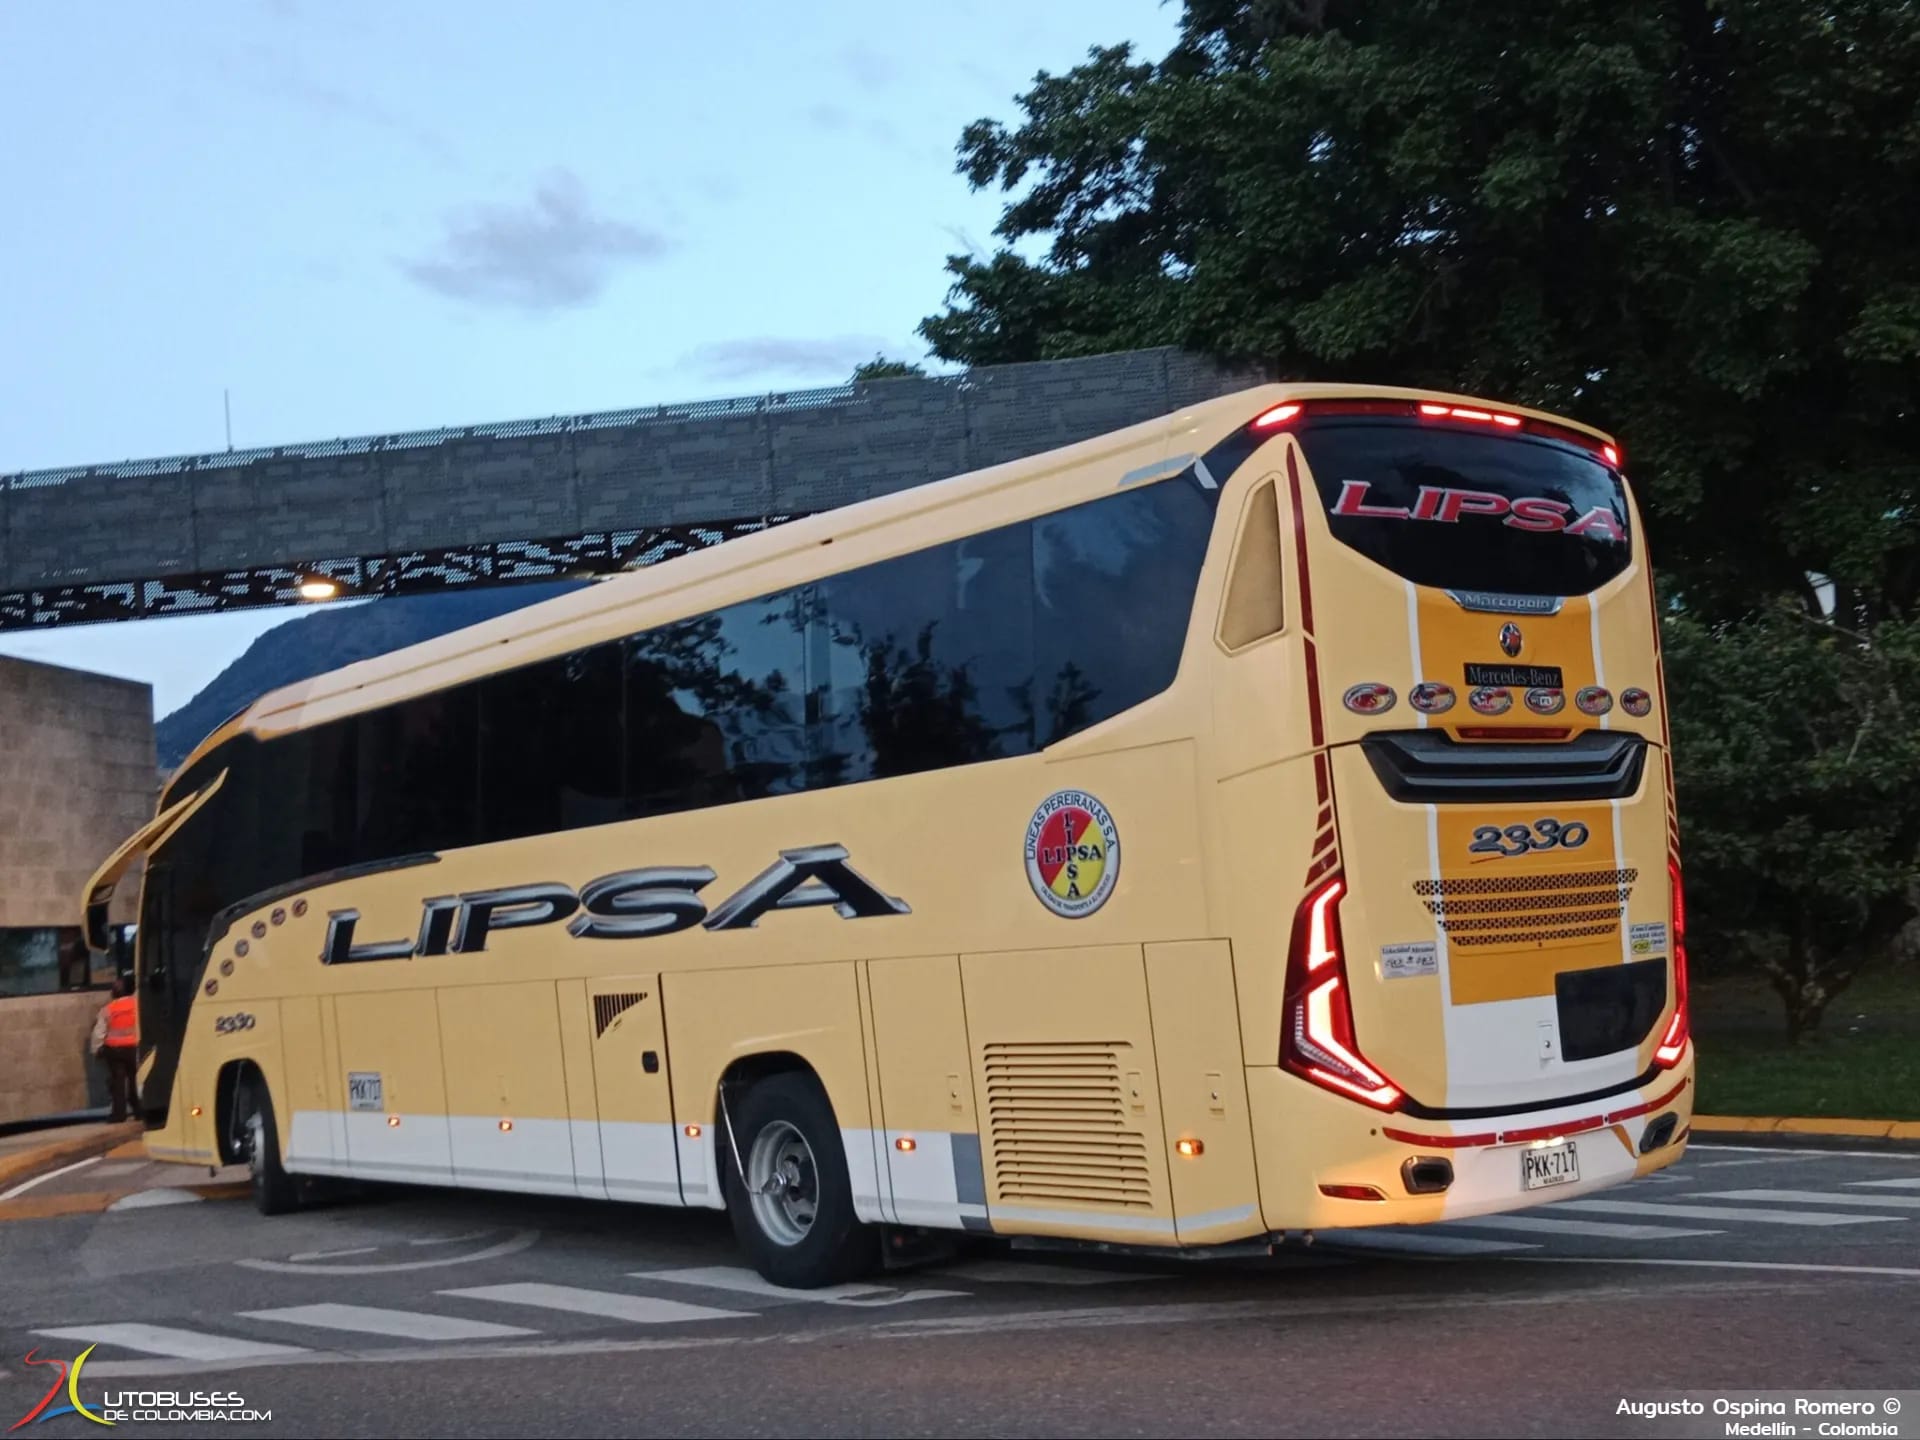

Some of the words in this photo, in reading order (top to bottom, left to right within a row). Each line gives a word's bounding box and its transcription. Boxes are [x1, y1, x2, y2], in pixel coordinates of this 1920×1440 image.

[1331, 480, 1628, 542] LIPSA
[1469, 665, 1560, 686] Mercedes-Benz
[1044, 793, 1108, 826] PEREIRANAS
[1469, 818, 1589, 856] 2330
[1044, 844, 1102, 864] LIPSA
[318, 843, 912, 965] LIPSA
[215, 1012, 256, 1034] 2330
